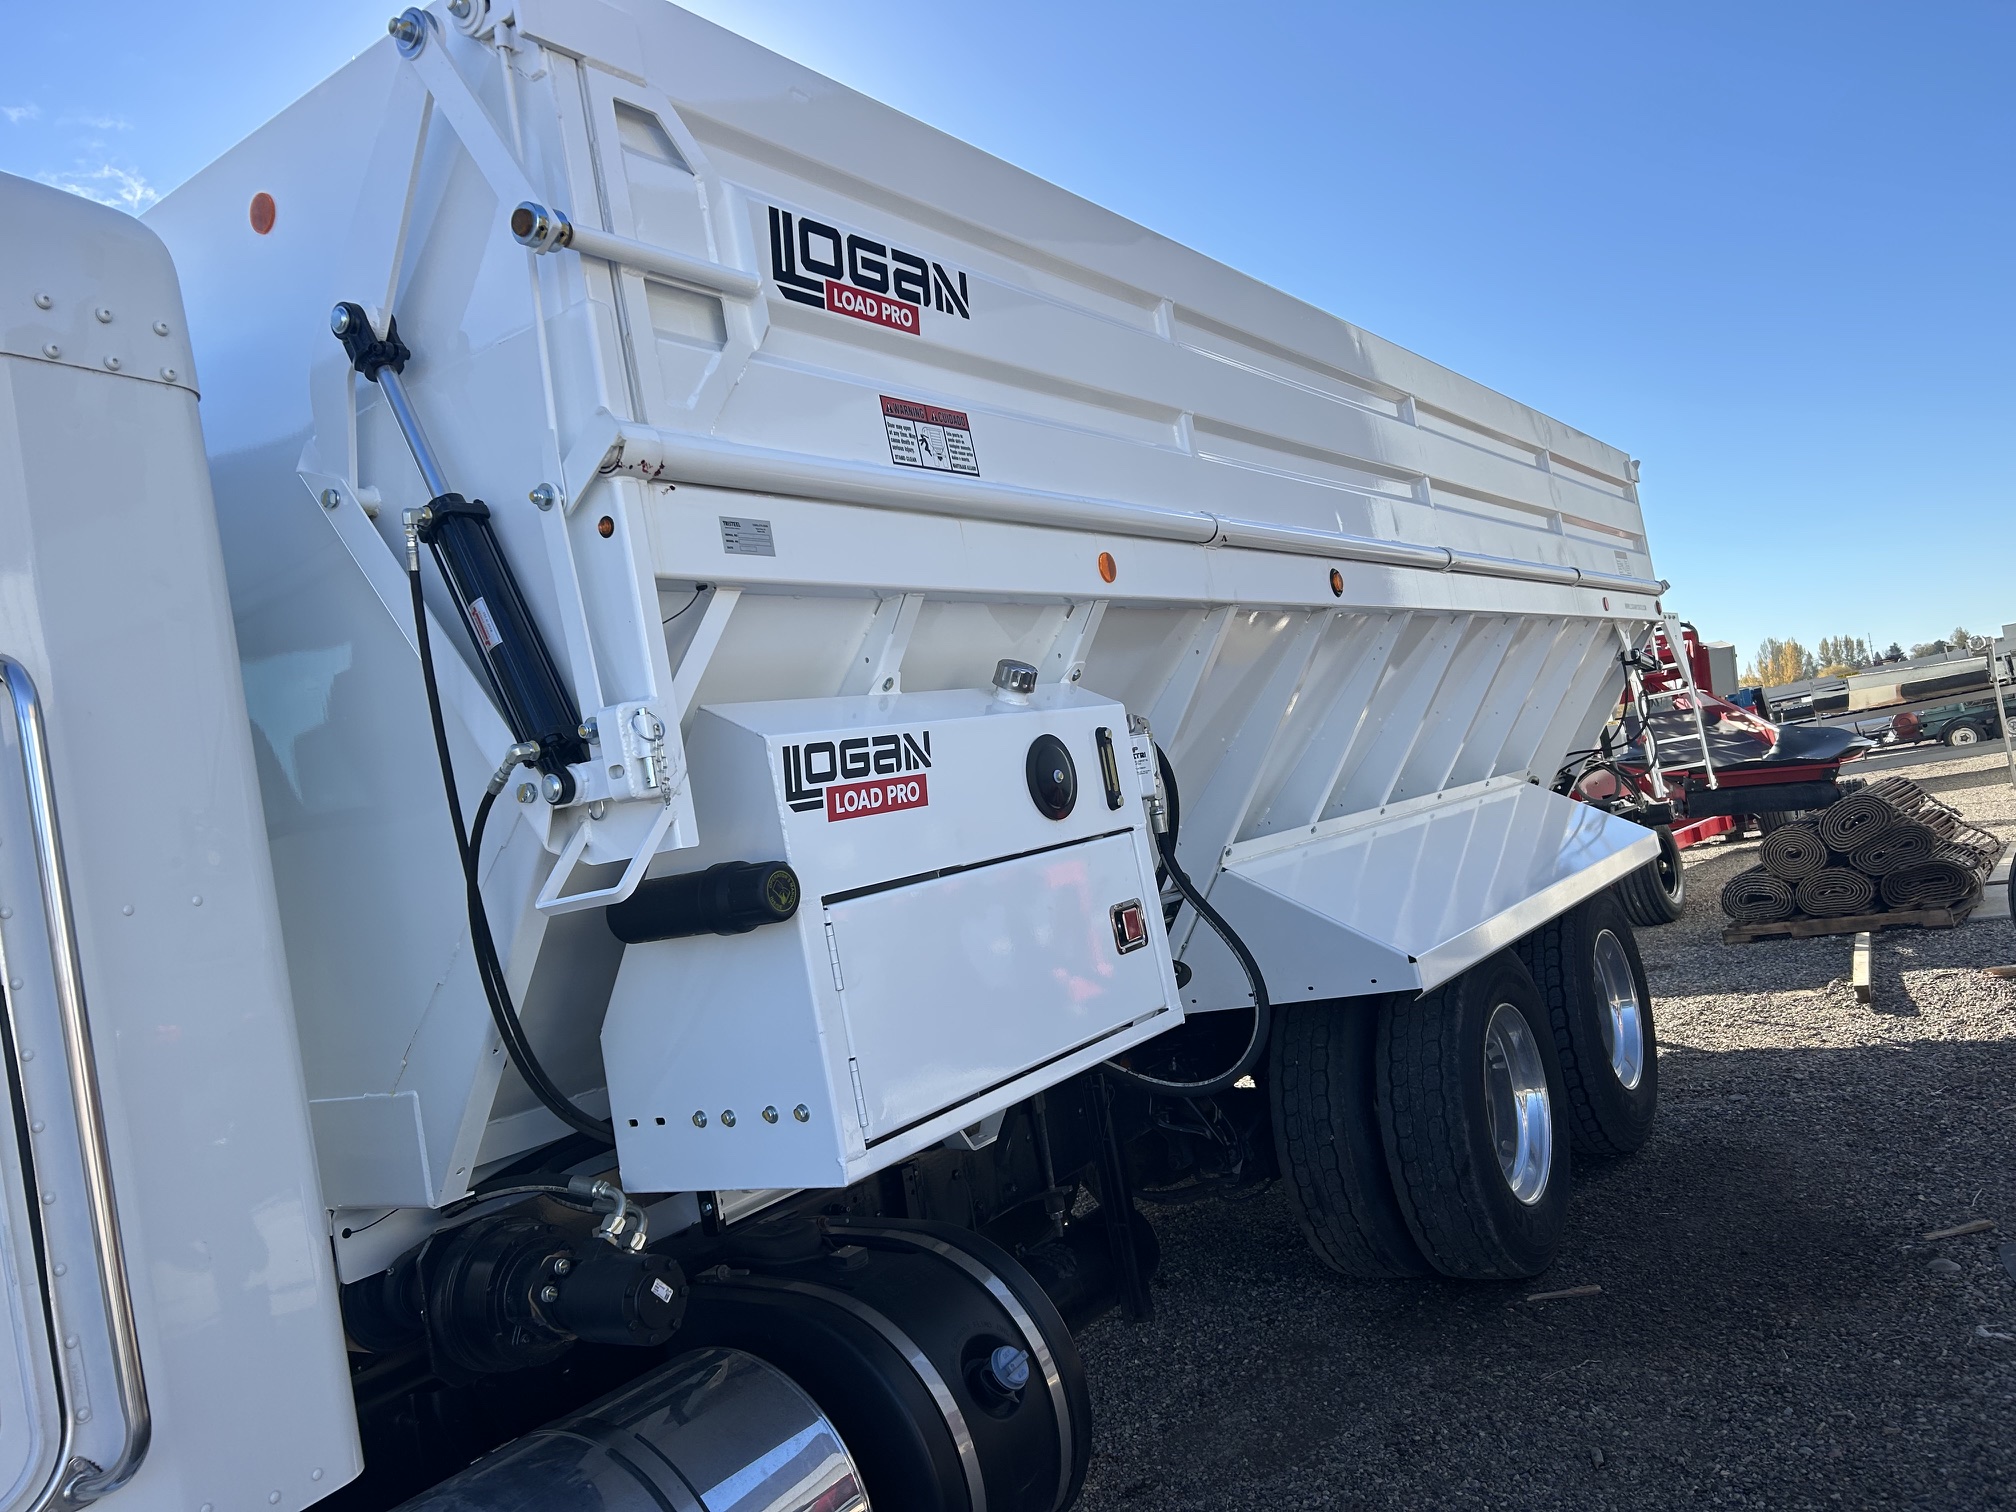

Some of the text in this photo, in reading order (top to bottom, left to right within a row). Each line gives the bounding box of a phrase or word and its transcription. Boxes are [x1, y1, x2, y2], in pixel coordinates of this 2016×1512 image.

[833, 288, 913, 328] LOAD PRO
[893, 402, 924, 418] WARNING
[835, 782, 920, 814] LOAD PRO
